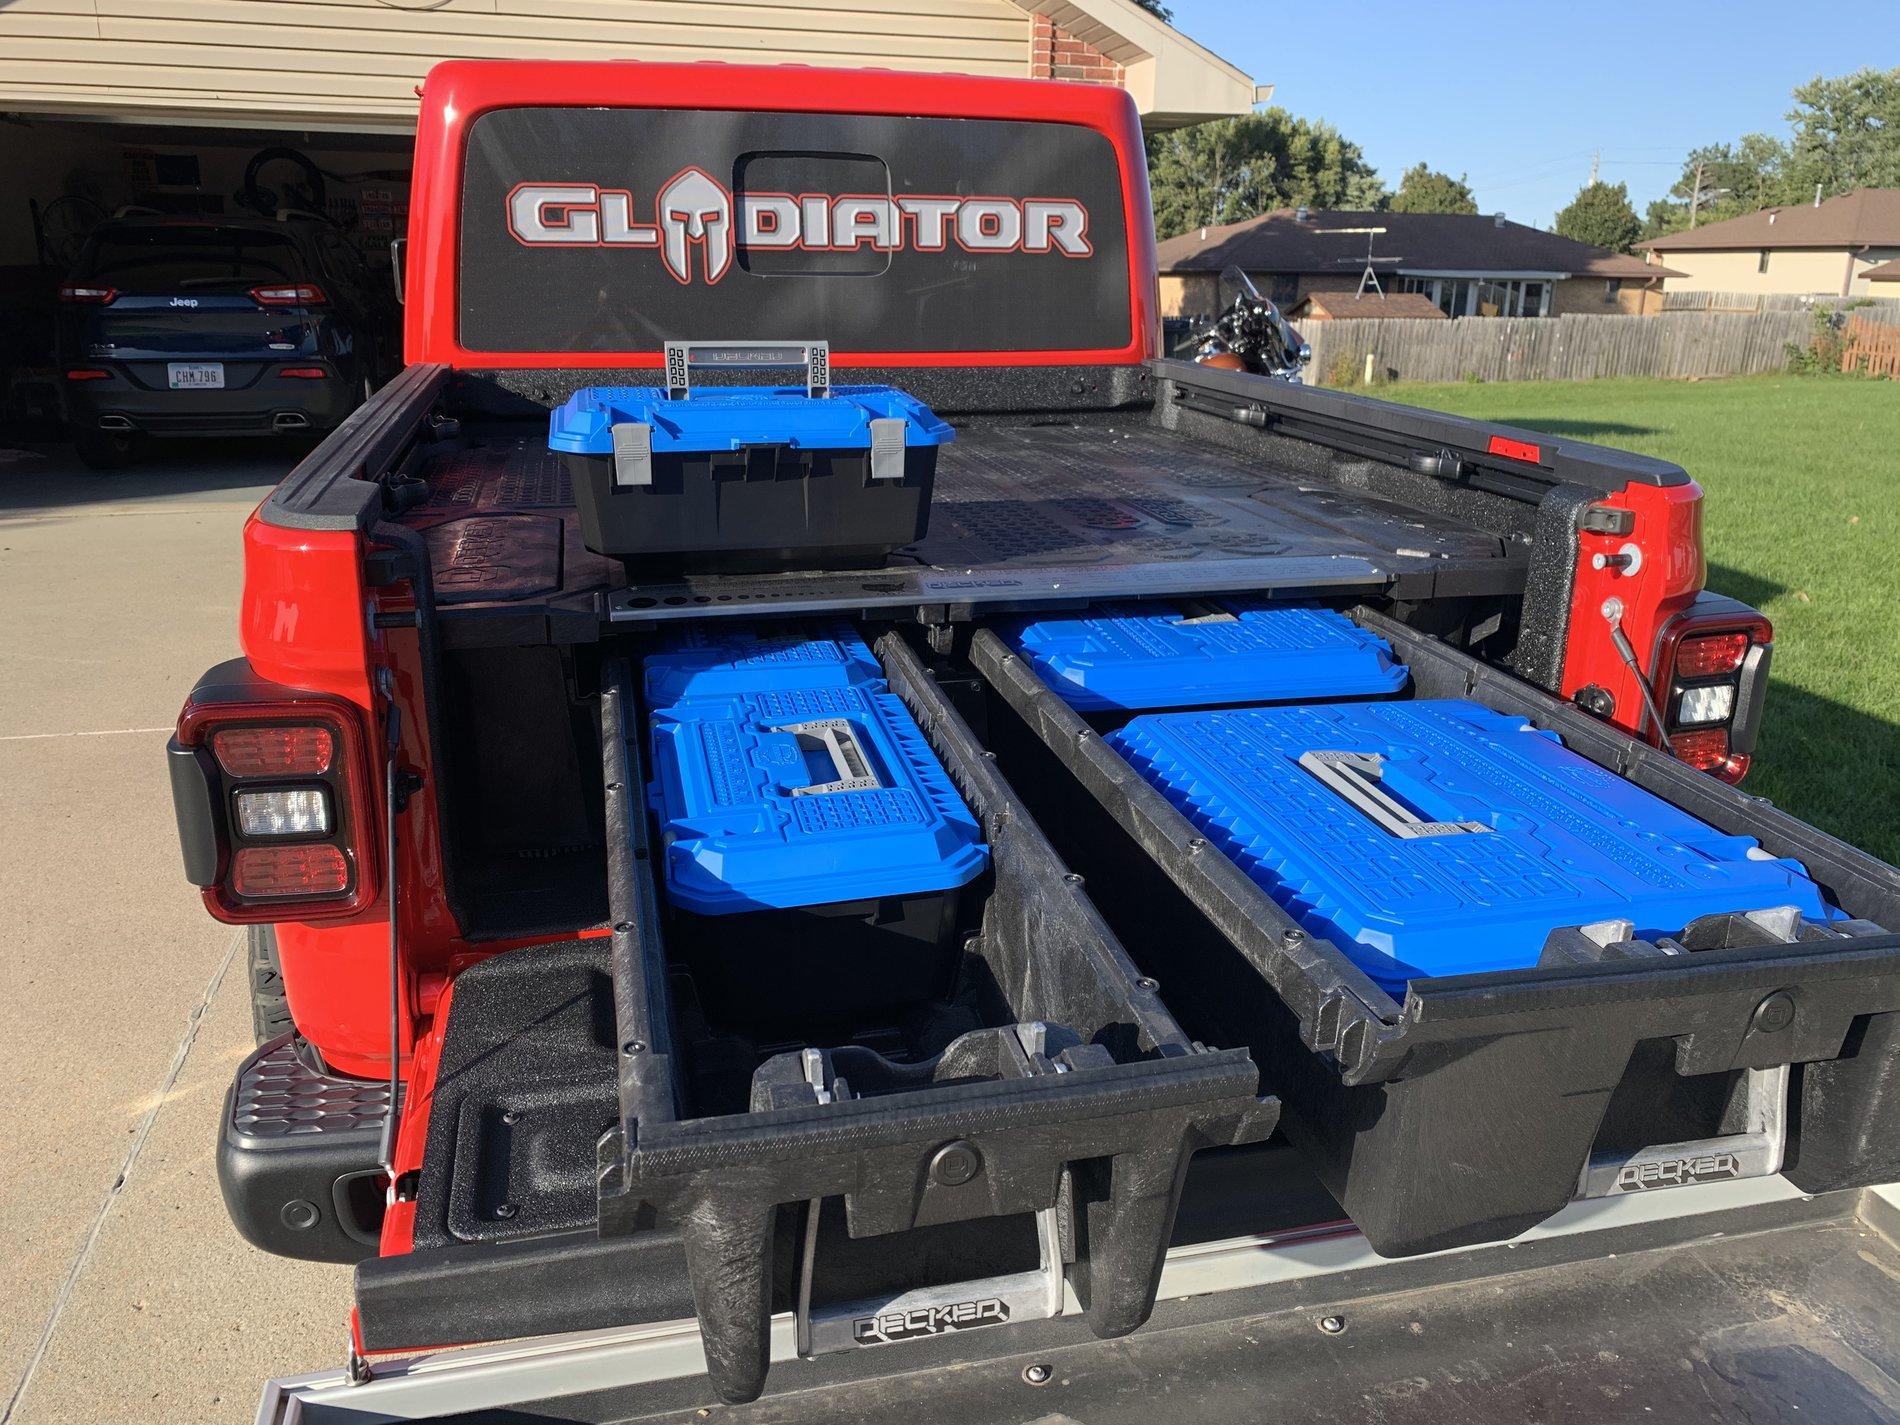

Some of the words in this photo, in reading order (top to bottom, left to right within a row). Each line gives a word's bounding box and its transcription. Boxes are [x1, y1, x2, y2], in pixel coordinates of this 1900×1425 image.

[169, 297, 199, 308] Jeep
[176, 370, 196, 383] CHM
[198, 370, 217, 383] 796
[1618, 1153, 1740, 1191] DECKED
[853, 1297, 1010, 1345] DECKED
